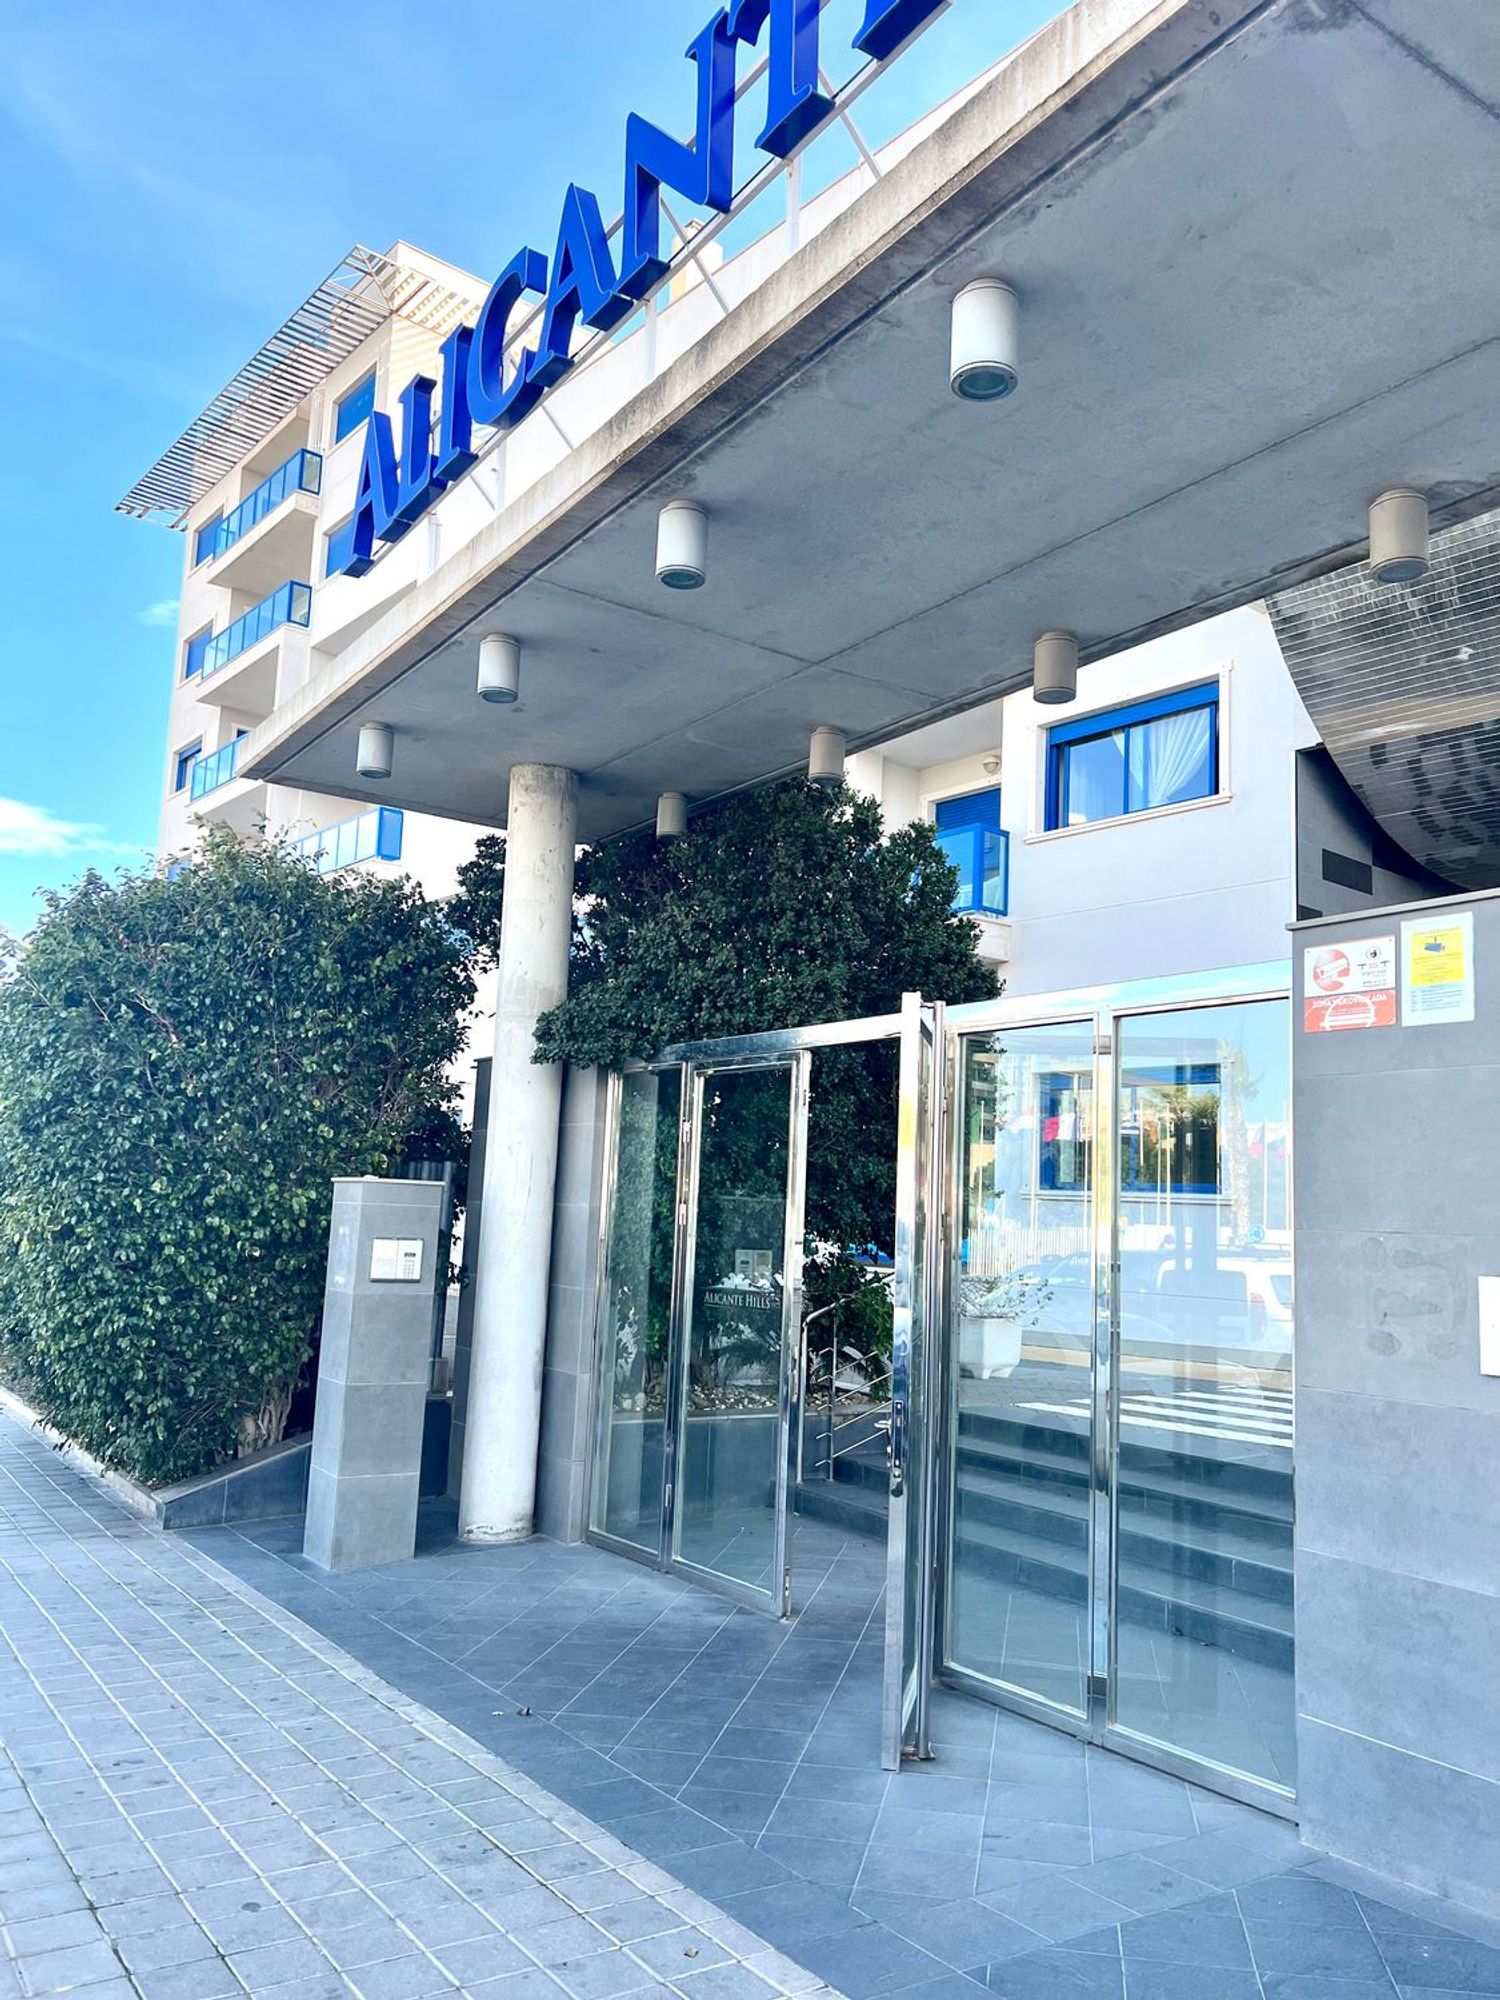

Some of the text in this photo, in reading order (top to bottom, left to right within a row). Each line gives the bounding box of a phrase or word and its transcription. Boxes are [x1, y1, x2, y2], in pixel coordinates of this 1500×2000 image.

[342, 0, 942, 578] ALICANT
[704, 1291, 771, 1309] ALICANTE HILLS
